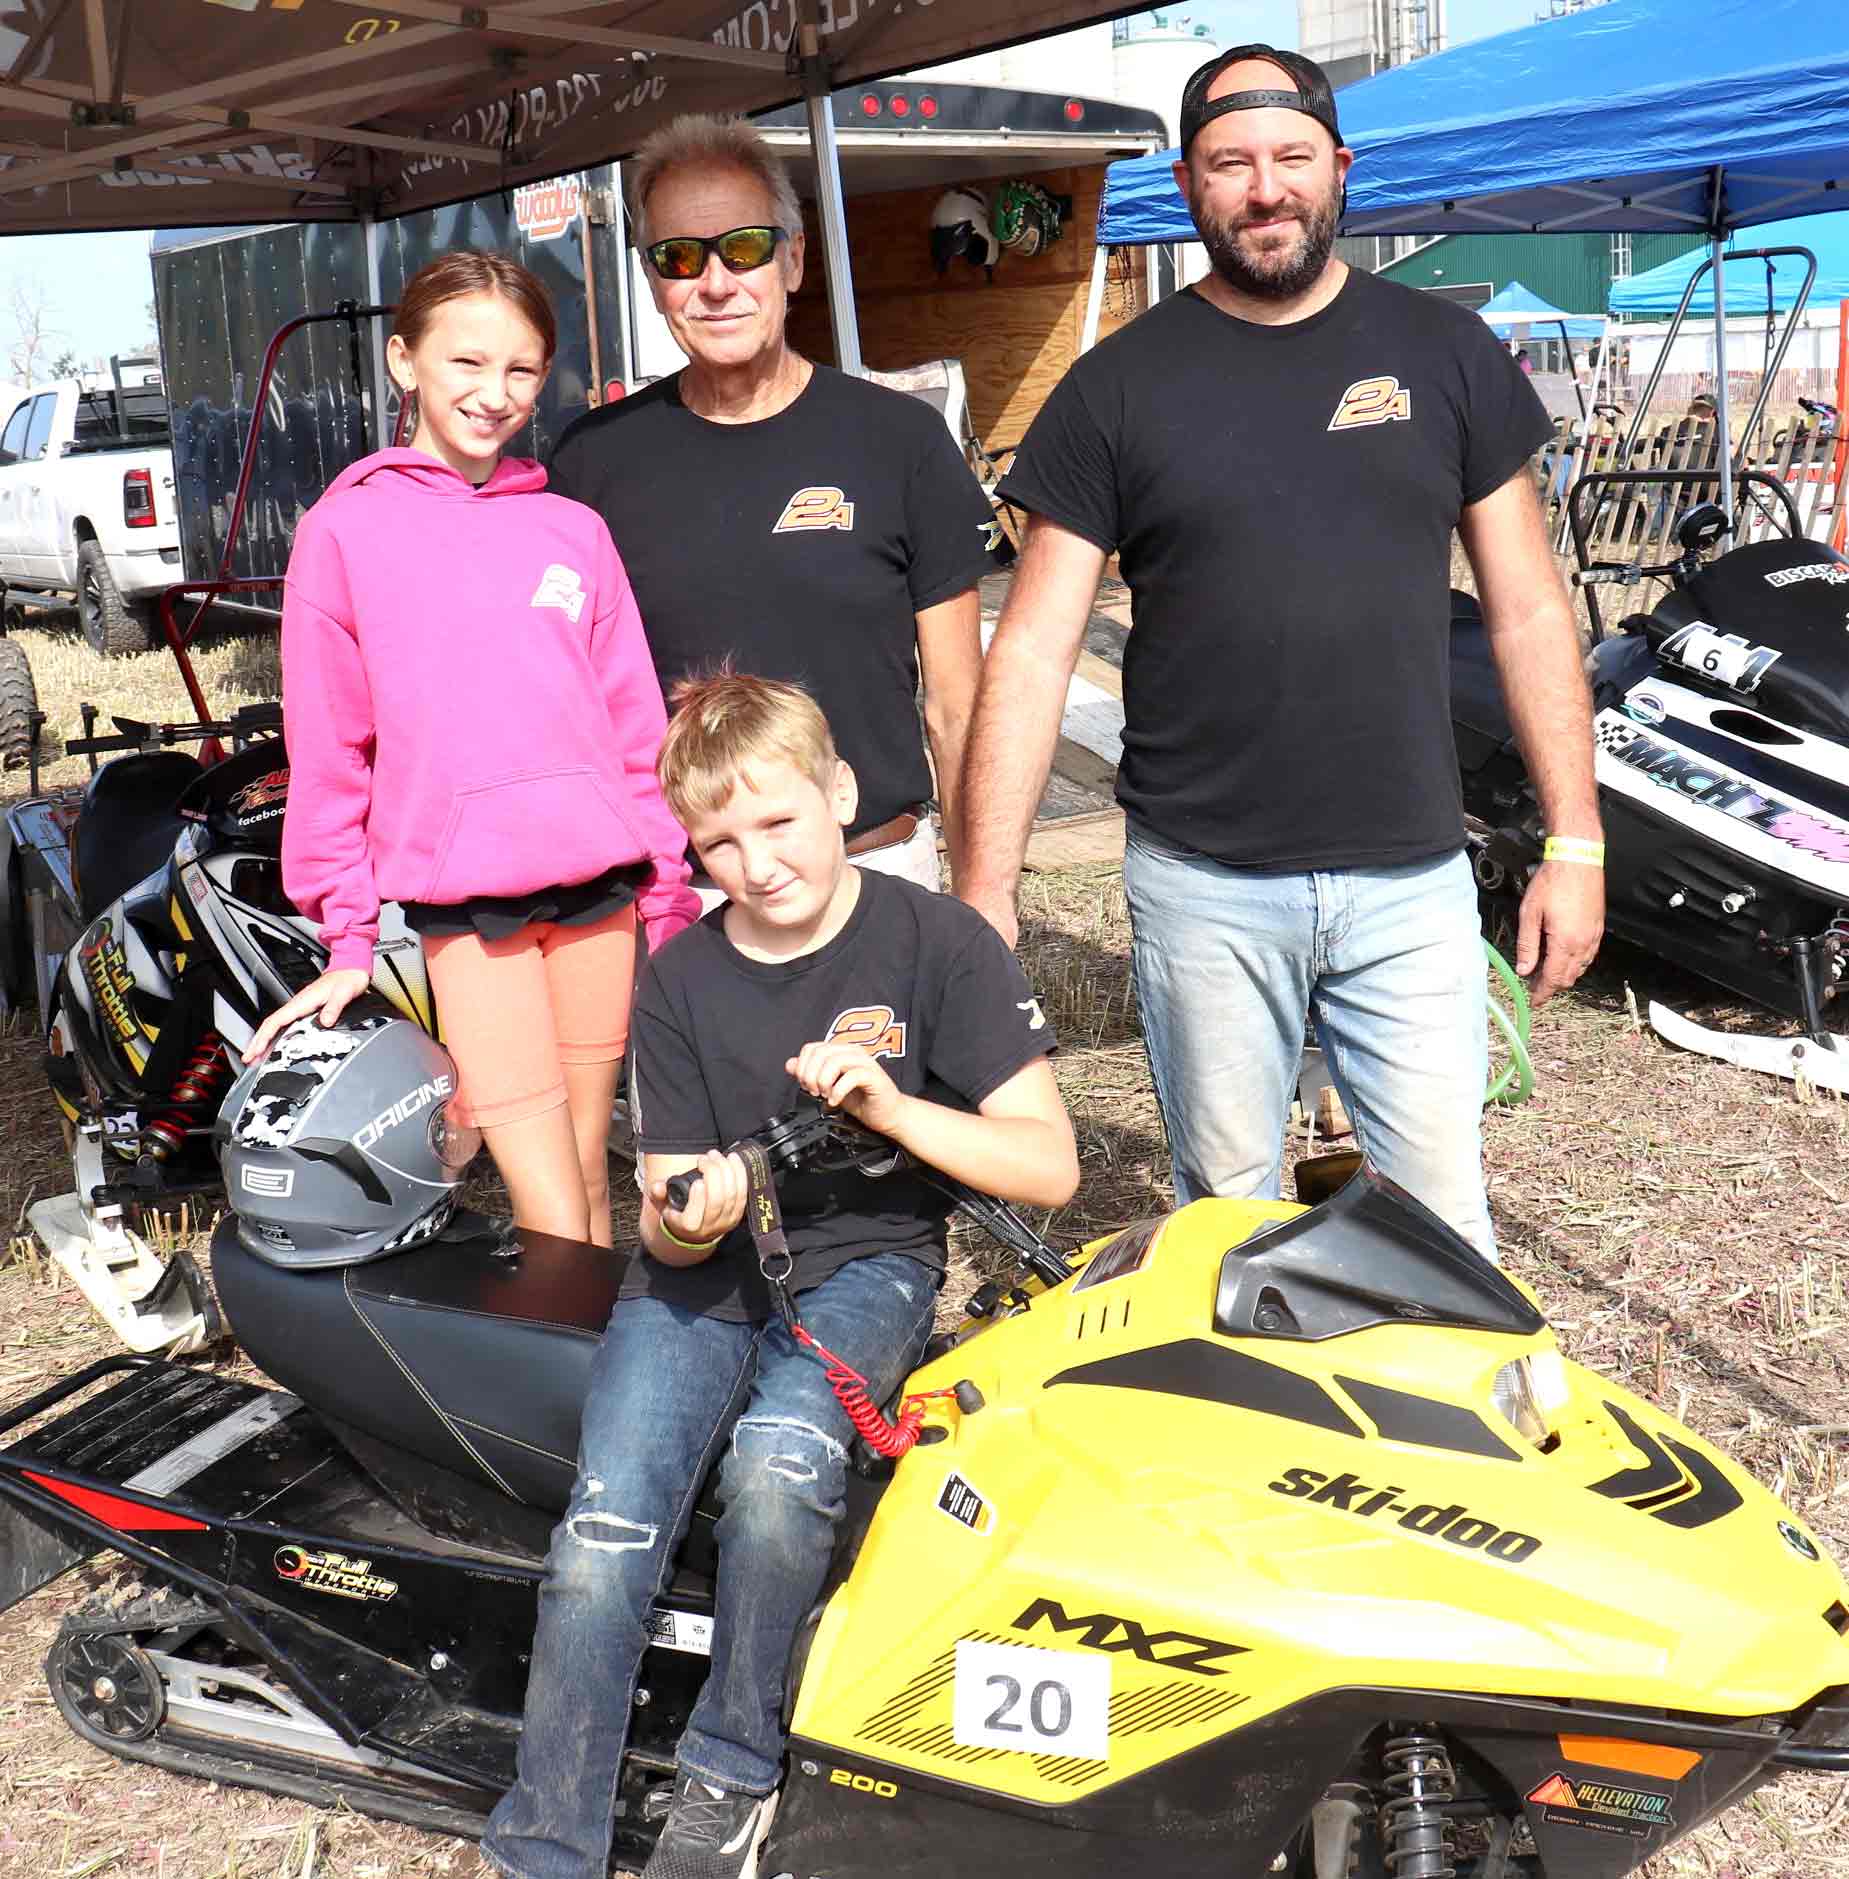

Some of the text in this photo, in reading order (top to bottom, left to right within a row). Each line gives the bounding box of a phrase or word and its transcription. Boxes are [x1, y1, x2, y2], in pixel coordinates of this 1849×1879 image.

[1703, 649, 1722, 671] 6
[1612, 735, 1795, 831] MACH Z
[88, 944, 137, 1038] Throttle
[107, 944, 136, 993] Full
[352, 1074, 452, 1151] ORIGINE
[1269, 1467, 1542, 1563] ski-doo
[304, 1564, 397, 1594] Throttle
[323, 1554, 368, 1575] Full
[1011, 1597, 1254, 1676] MXZ
[984, 1674, 1073, 1737] 20
[830, 1768, 898, 1799] 200
[1577, 1785, 1665, 1812] HELLEVATION
